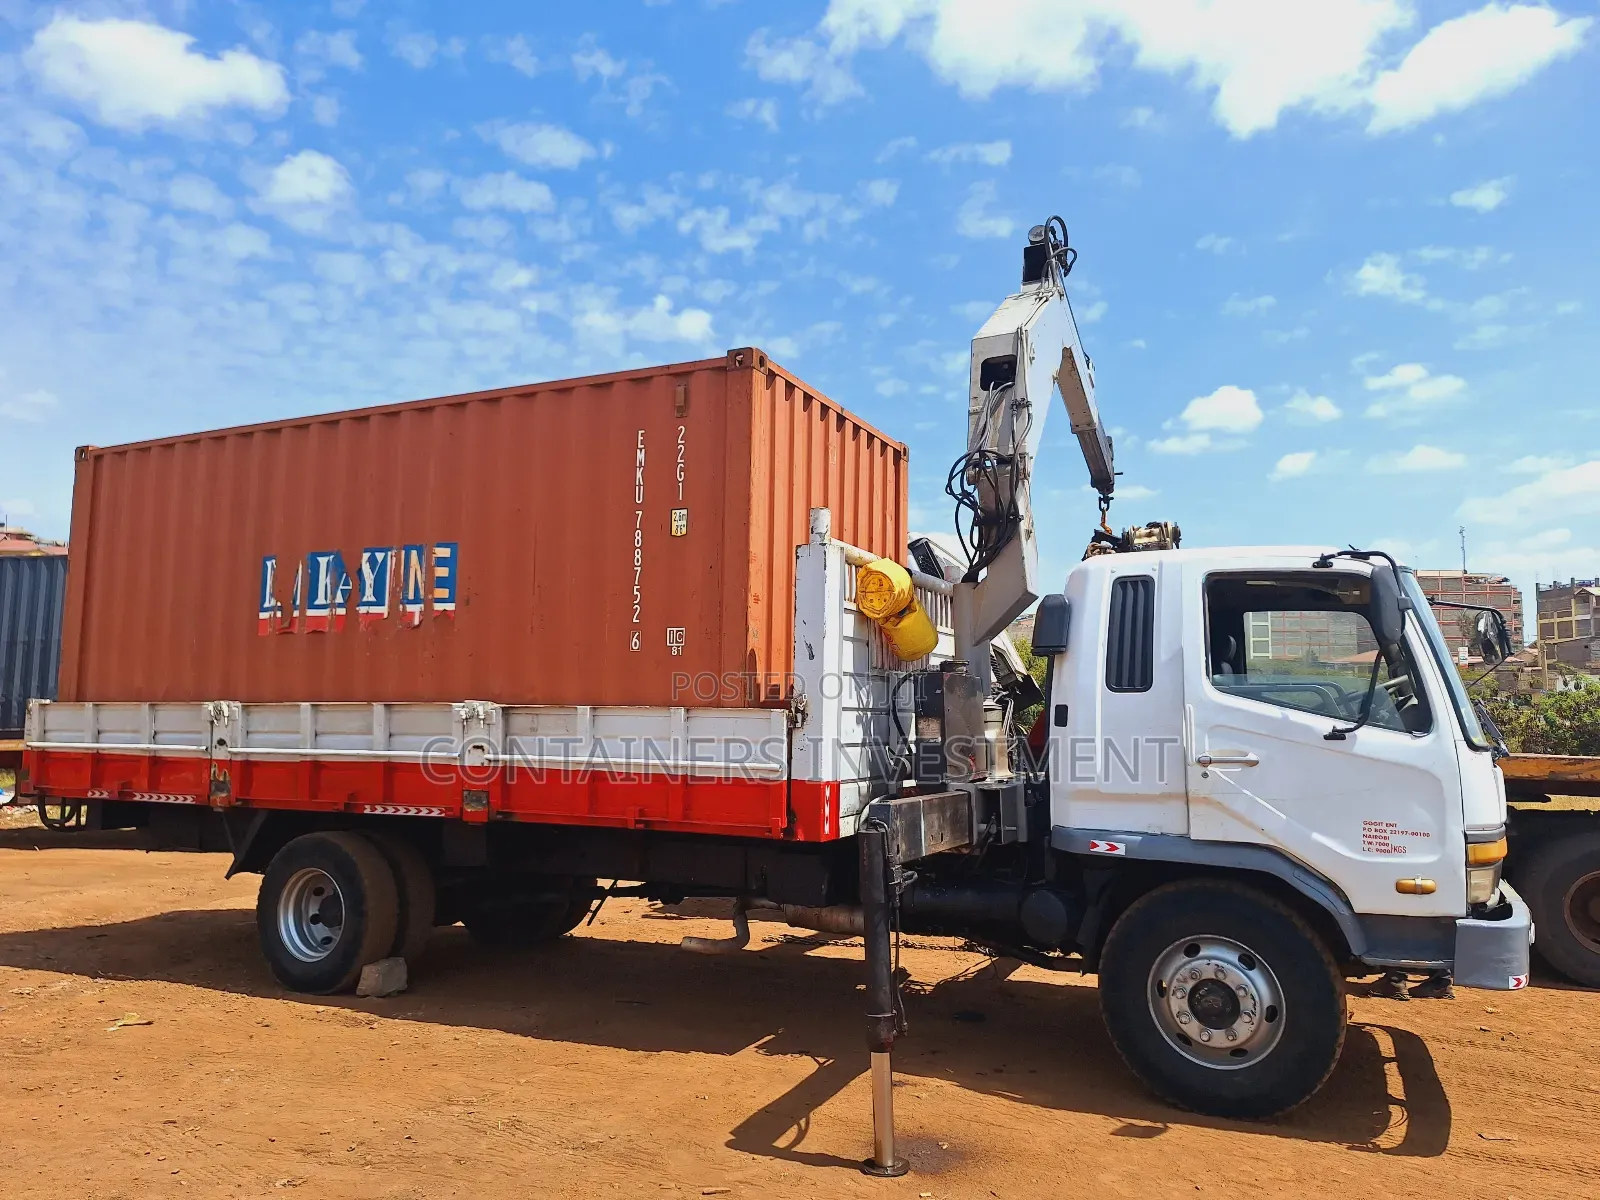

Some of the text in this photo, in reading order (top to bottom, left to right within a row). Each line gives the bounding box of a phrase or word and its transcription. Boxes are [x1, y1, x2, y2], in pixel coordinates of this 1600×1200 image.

[677, 425, 686, 501] 22G1
[631, 430, 645, 650] EMKU 788752 6
[671, 646, 682, 656] 81
[1362, 833, 1390, 841] NAIROBI
[1389, 829, 1431, 838] 22197-00100
